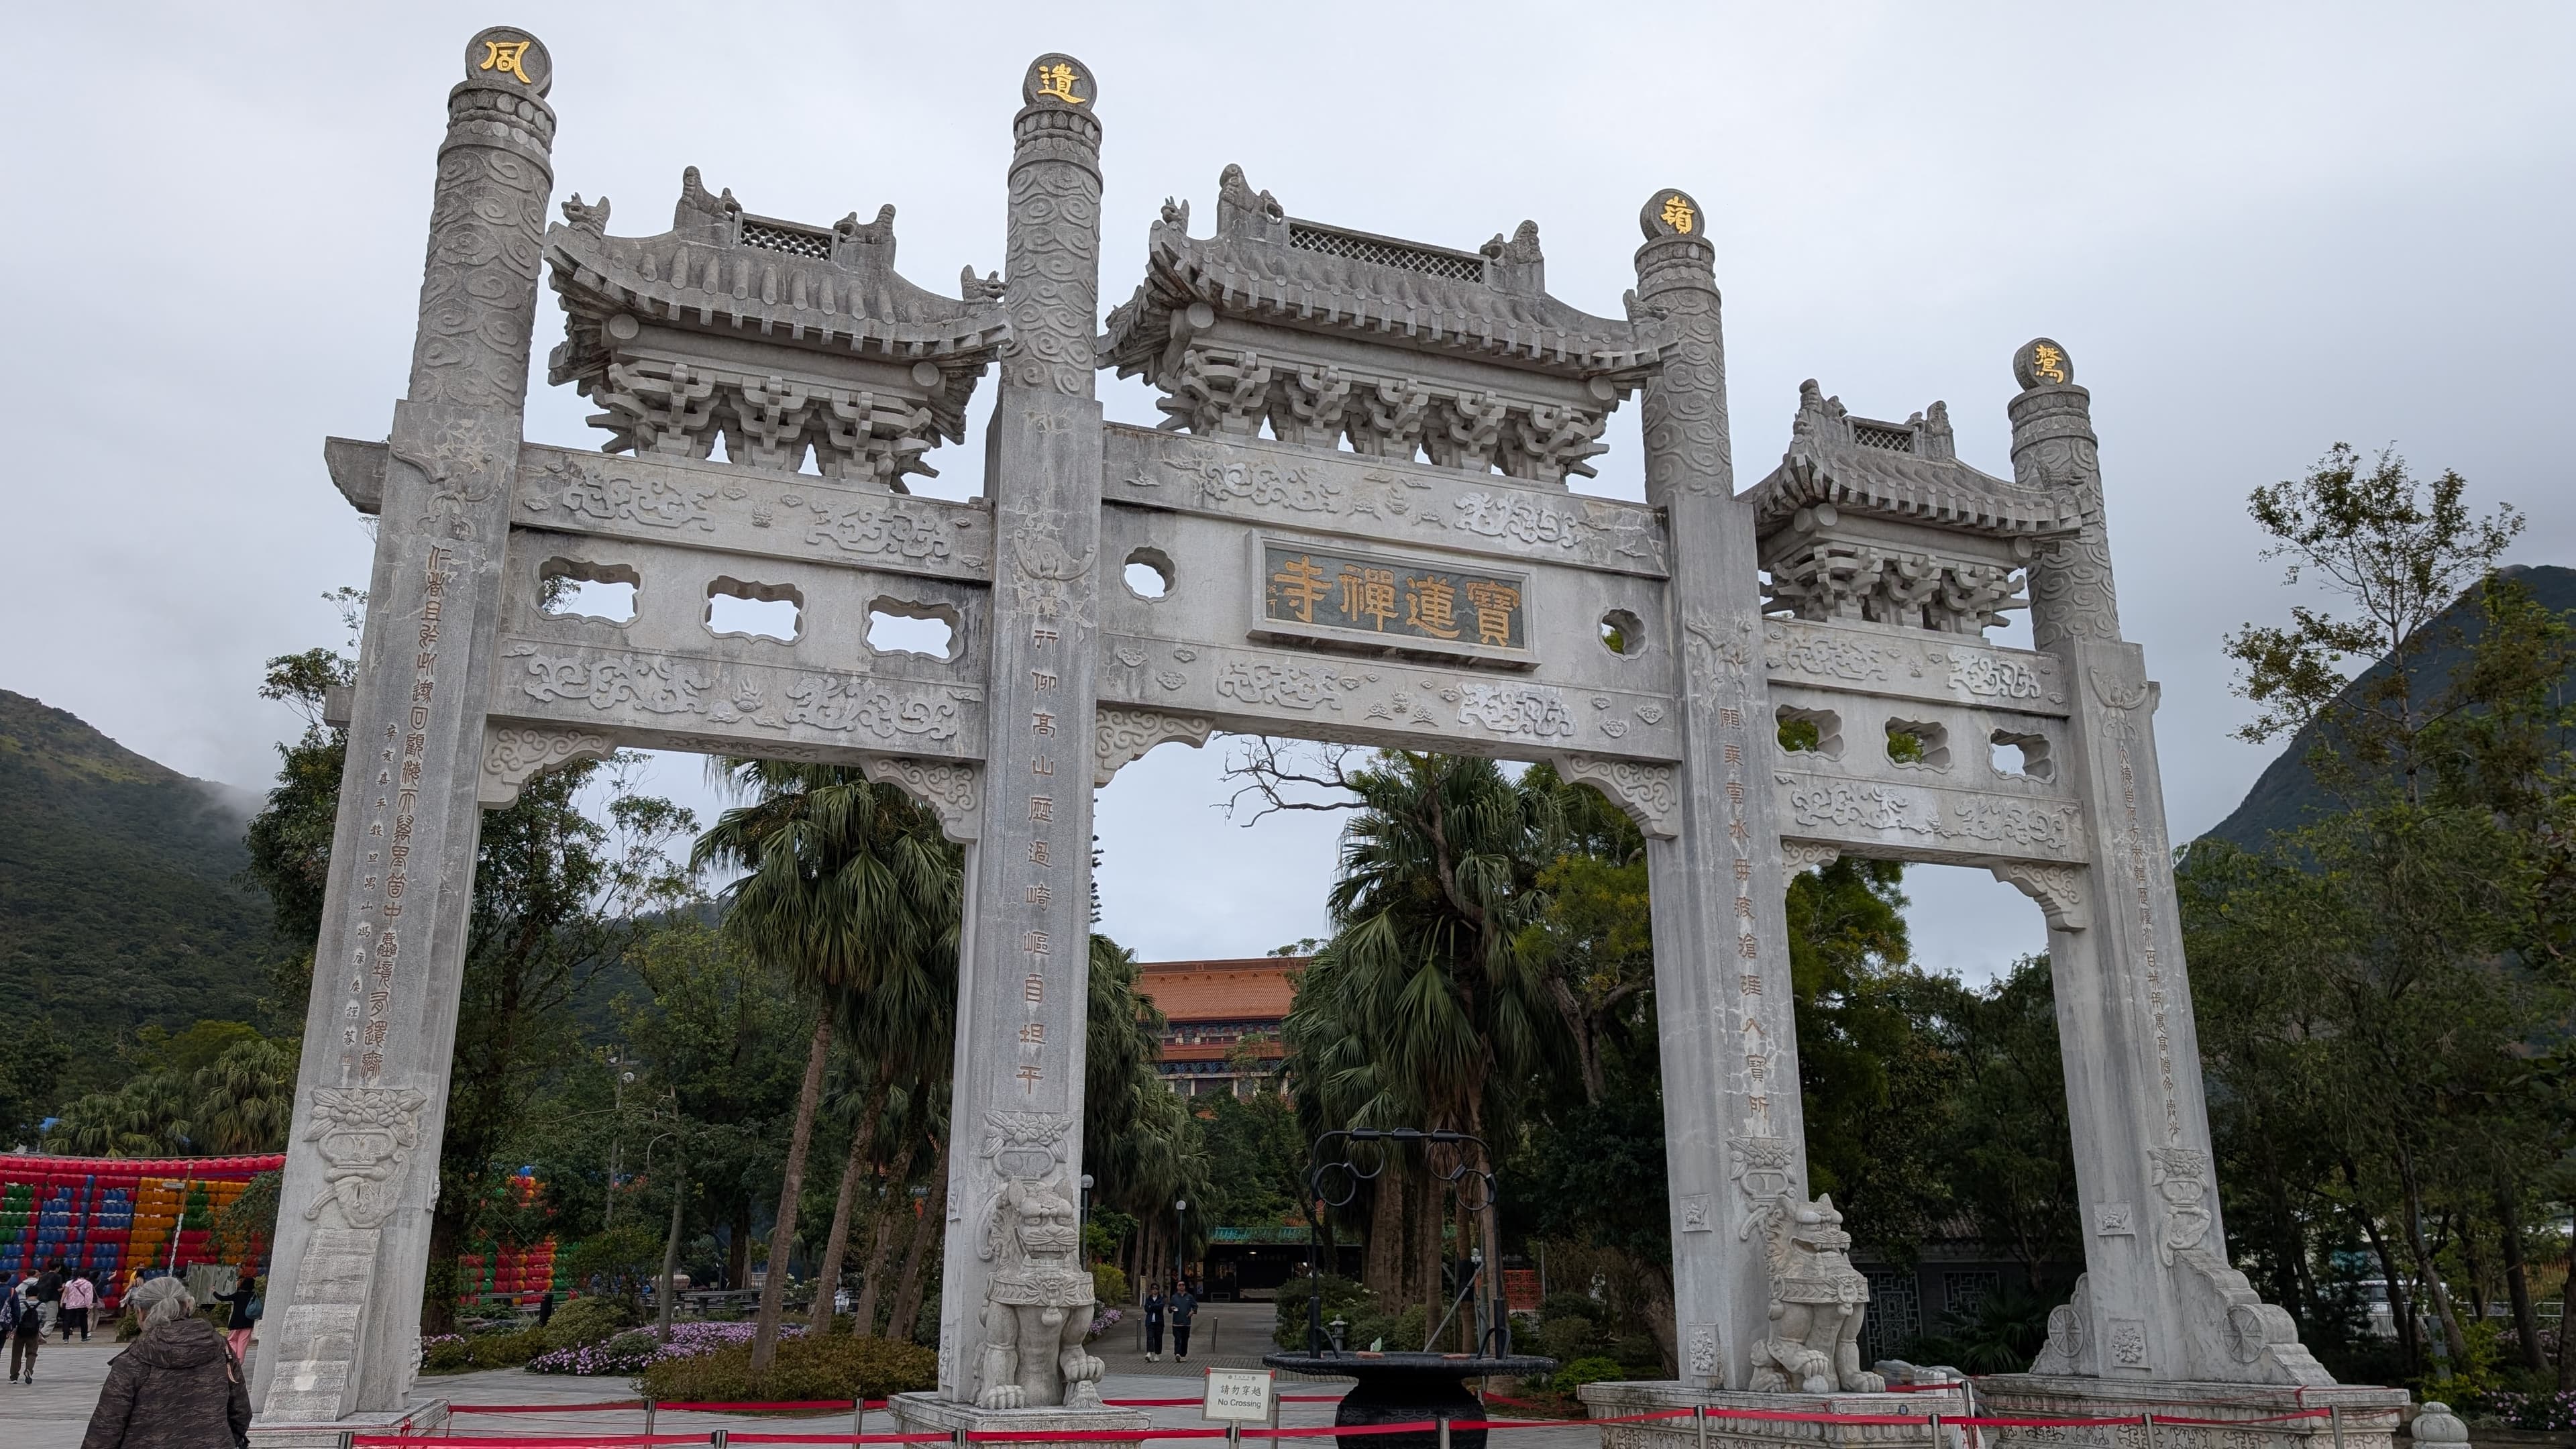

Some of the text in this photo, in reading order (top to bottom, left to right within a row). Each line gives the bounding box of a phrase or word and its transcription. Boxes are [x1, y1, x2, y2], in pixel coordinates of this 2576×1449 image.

[1038, 63, 1086, 103] 遺
[1660, 195, 1695, 234] 嶺
[2034, 344, 2064, 383] 鷲
[1218, 1398, 1261, 1409] No Crossing
[1220, 1384, 1262, 1396] 請勿穿越
